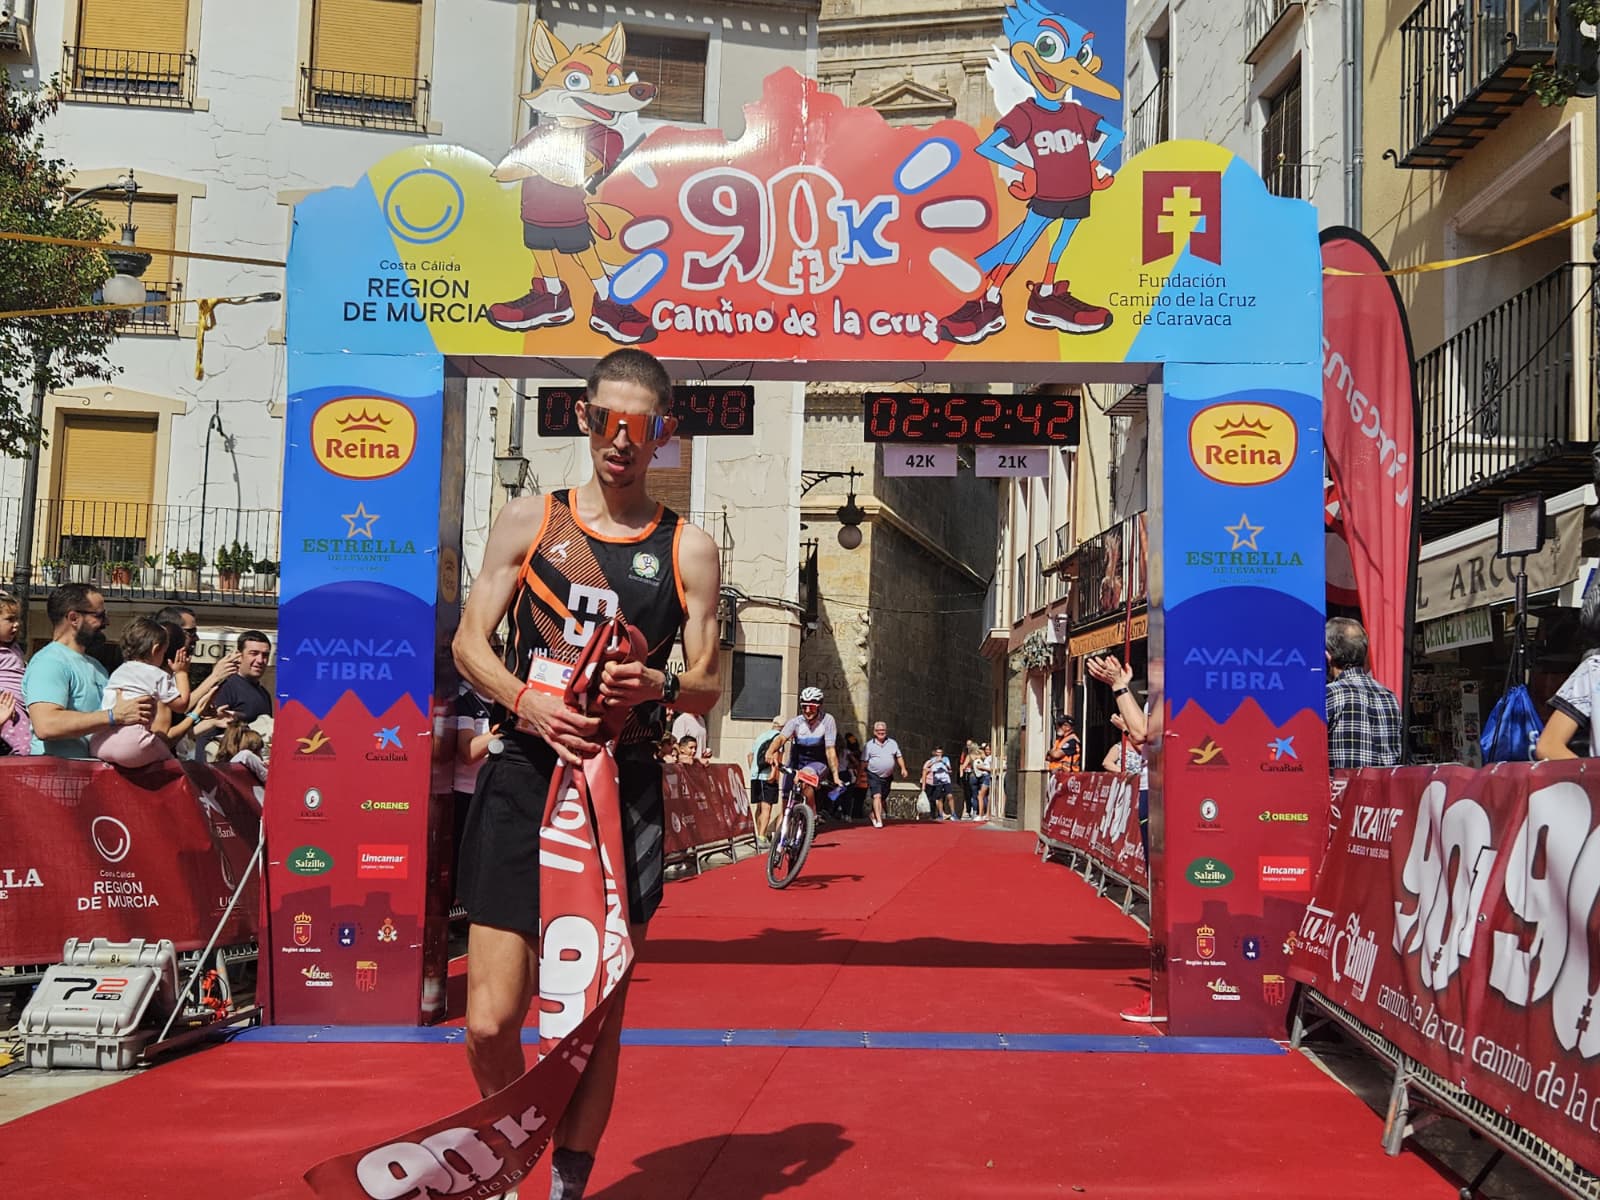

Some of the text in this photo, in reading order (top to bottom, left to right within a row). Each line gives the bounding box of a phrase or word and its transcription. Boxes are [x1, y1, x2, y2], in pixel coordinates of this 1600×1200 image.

[380, 260, 461, 272] Costa Cálida
[368, 275, 469, 298] REGIÓN
[1139, 273, 1226, 288] Fundación
[1109, 292, 1256, 307] Camino de la Cruz
[343, 302, 488, 323] DE MURCIA
[1132, 311, 1232, 326] de Caravaca
[783, 308, 817, 337] de
[833, 299, 861, 335] la
[869, 310, 940, 344] cruz
[870, 398, 1075, 440] 02:52:42
[326, 437, 401, 459] Reina
[1205, 444, 1283, 465] Reina
[905, 455, 936, 469] 42K
[998, 456, 1028, 469] 21K
[302, 538, 417, 555] ESTRELLA
[1185, 551, 1304, 567] ESTRELLA
[316, 662, 393, 680] FIBRA
[1205, 671, 1285, 690] FIBRA
[373, 802, 409, 810] ORENES
[1271, 813, 1309, 822] ORENES
[295, 859, 326, 868] Salzillo
[1262, 865, 1306, 875] Limcamar
[1194, 871, 1226, 880] Salzillo
[94, 880, 143, 895] REGIÓN
[77, 894, 160, 911] DE MURCIA
[1377, 984, 1409, 1022] camino
[1422, 1002, 1439, 1039] la
[1471, 1035, 1532, 1092] camino
[1535, 1061, 1566, 1109] de
[1565, 1072, 1589, 1122] la
[477, 1180, 501, 1196] de
[503, 1169, 524, 1185] la
